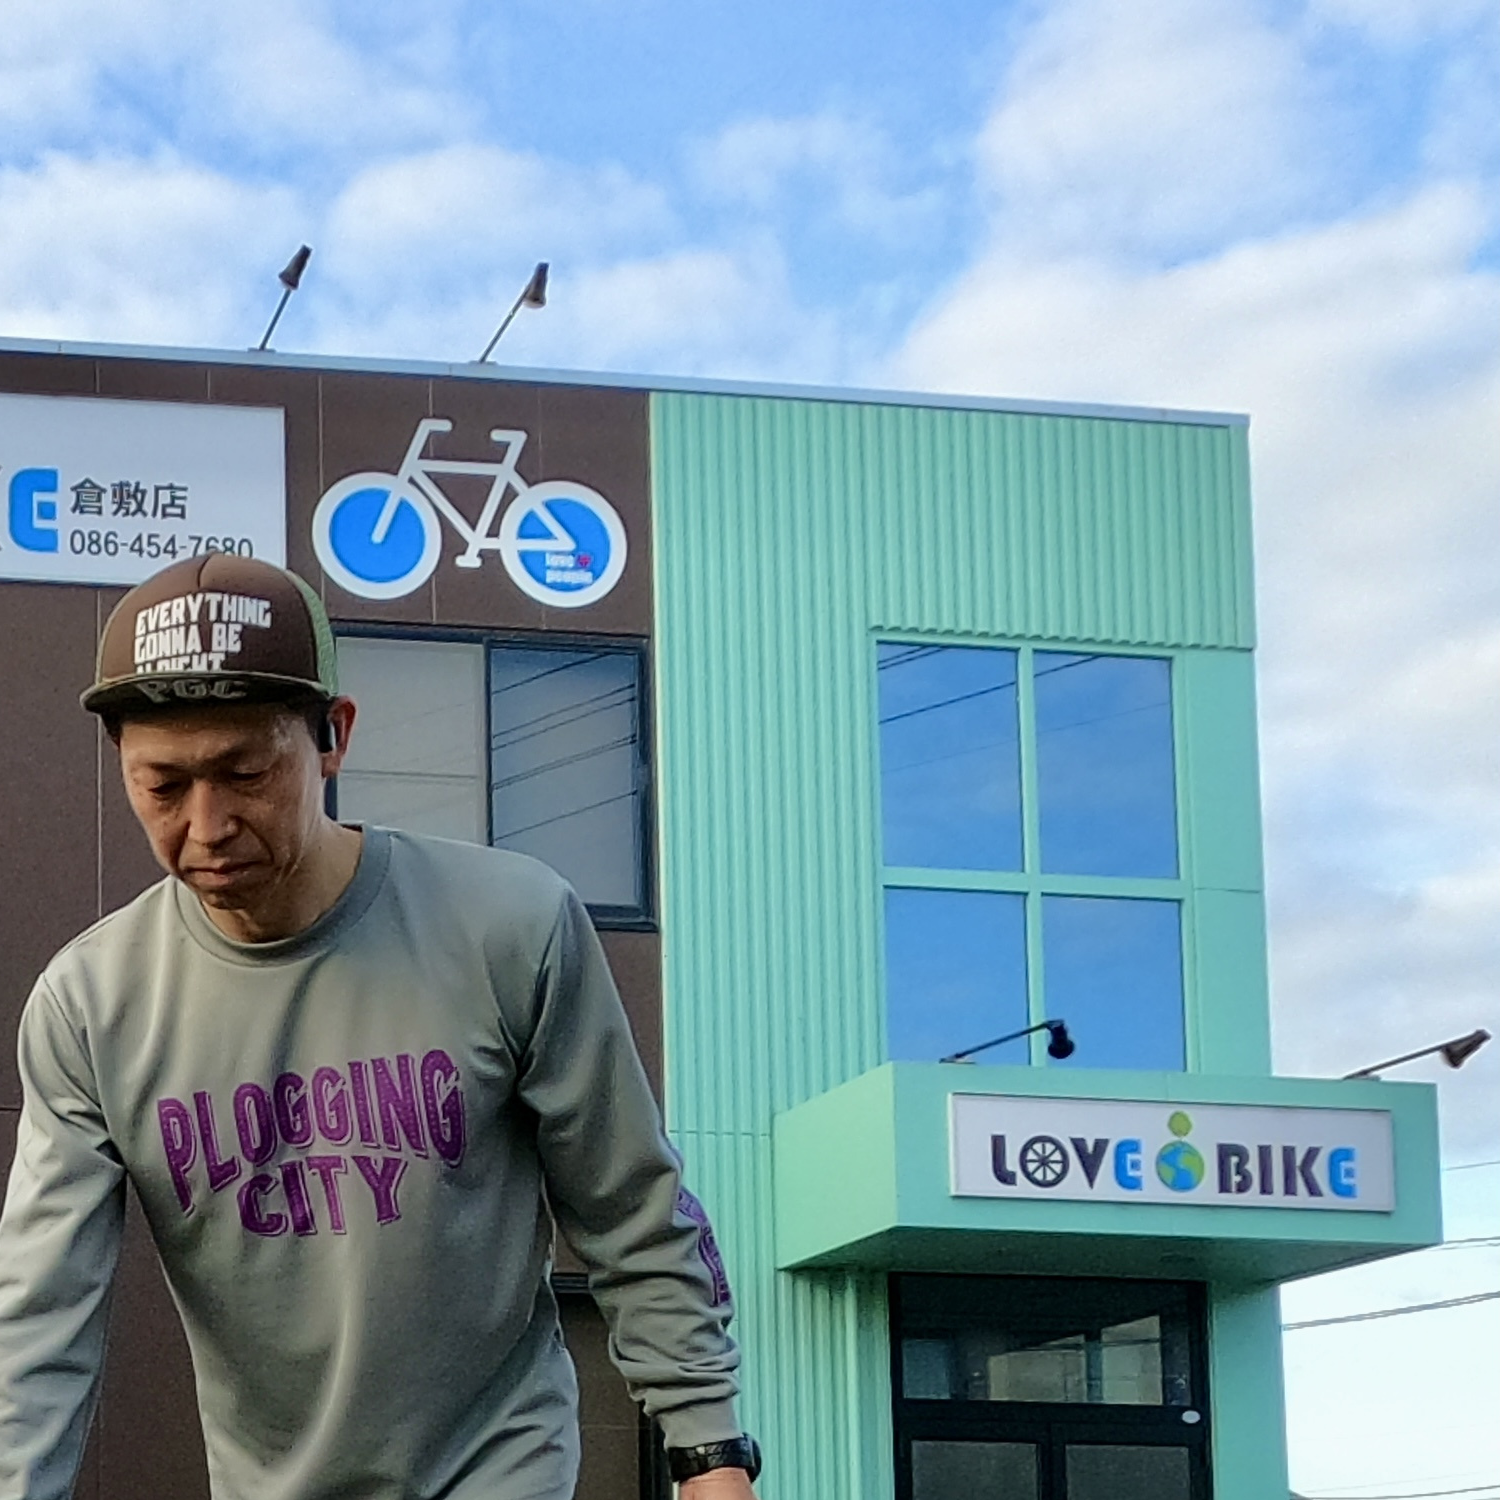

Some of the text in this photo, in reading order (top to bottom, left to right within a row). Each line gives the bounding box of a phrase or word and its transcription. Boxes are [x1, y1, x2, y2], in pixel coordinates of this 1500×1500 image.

[70, 477, 189, 520] 倉敷店
[135, 592, 272, 636] EVERYTHING
[134, 622, 242, 664] GONNA BE
[157, 1048, 465, 1218] PLOGGING
[990, 1134, 1357, 1198] LOVE BIKE
[236, 1154, 409, 1238] CITY
